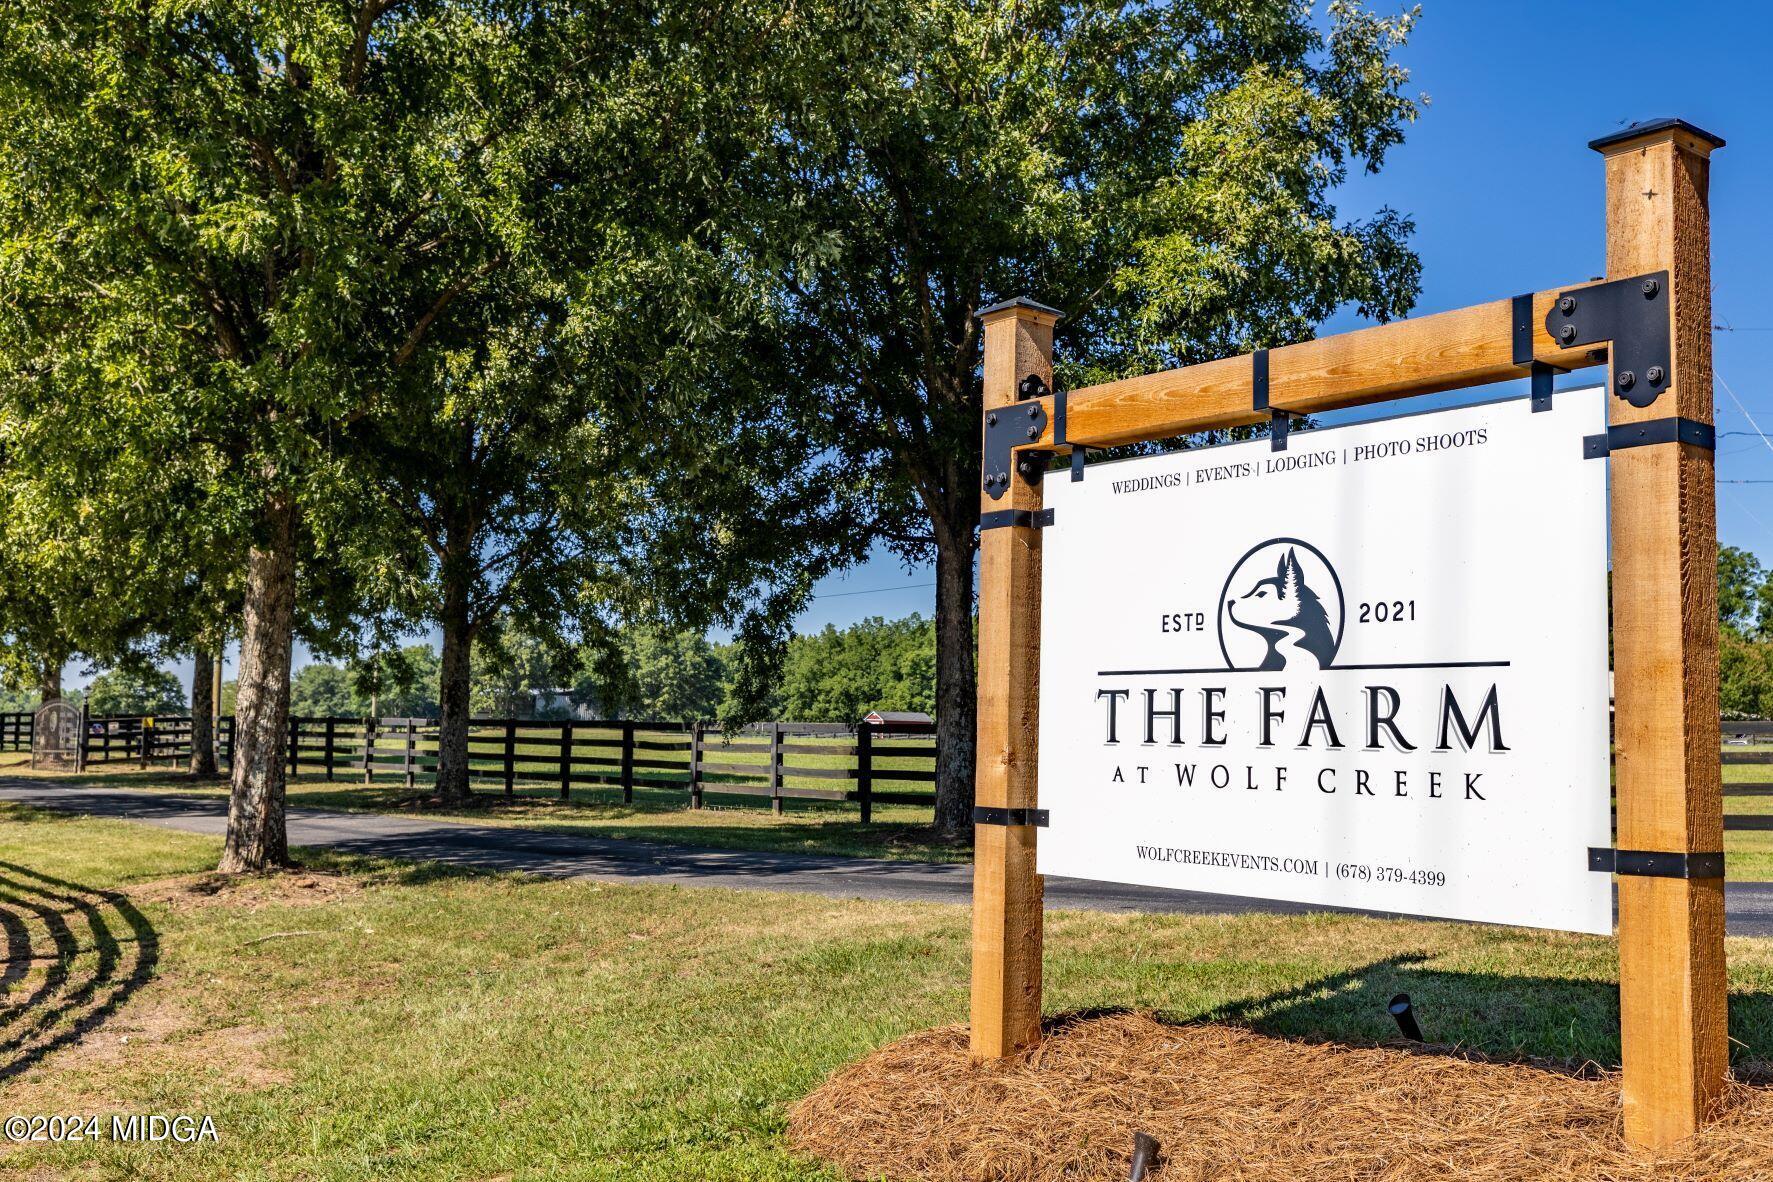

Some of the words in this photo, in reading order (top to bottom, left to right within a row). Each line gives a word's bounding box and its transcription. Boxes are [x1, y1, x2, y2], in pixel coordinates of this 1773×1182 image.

[1111, 472, 1182, 495] WEDDINGS
[1195, 463, 1251, 484] EVENTS
[1265, 450, 1336, 474] LODGING
[1353, 439, 1411, 462] PHOTO
[1415, 428, 1488, 453] SHOOTS
[1359, 599, 1416, 624] 2021
[1093, 686, 1228, 749] THE
[1254, 683, 1512, 755] FARM
[1111, 765, 1149, 784] AT
[1174, 763, 1288, 792] WOLF
[1317, 767, 1487, 801] CREEK
[1136, 845, 1319, 876] WOLFCREEKEVENTS.COM
[1336, 863, 1372, 883] (678)
[1376, 866, 1446, 887] 379-4399
